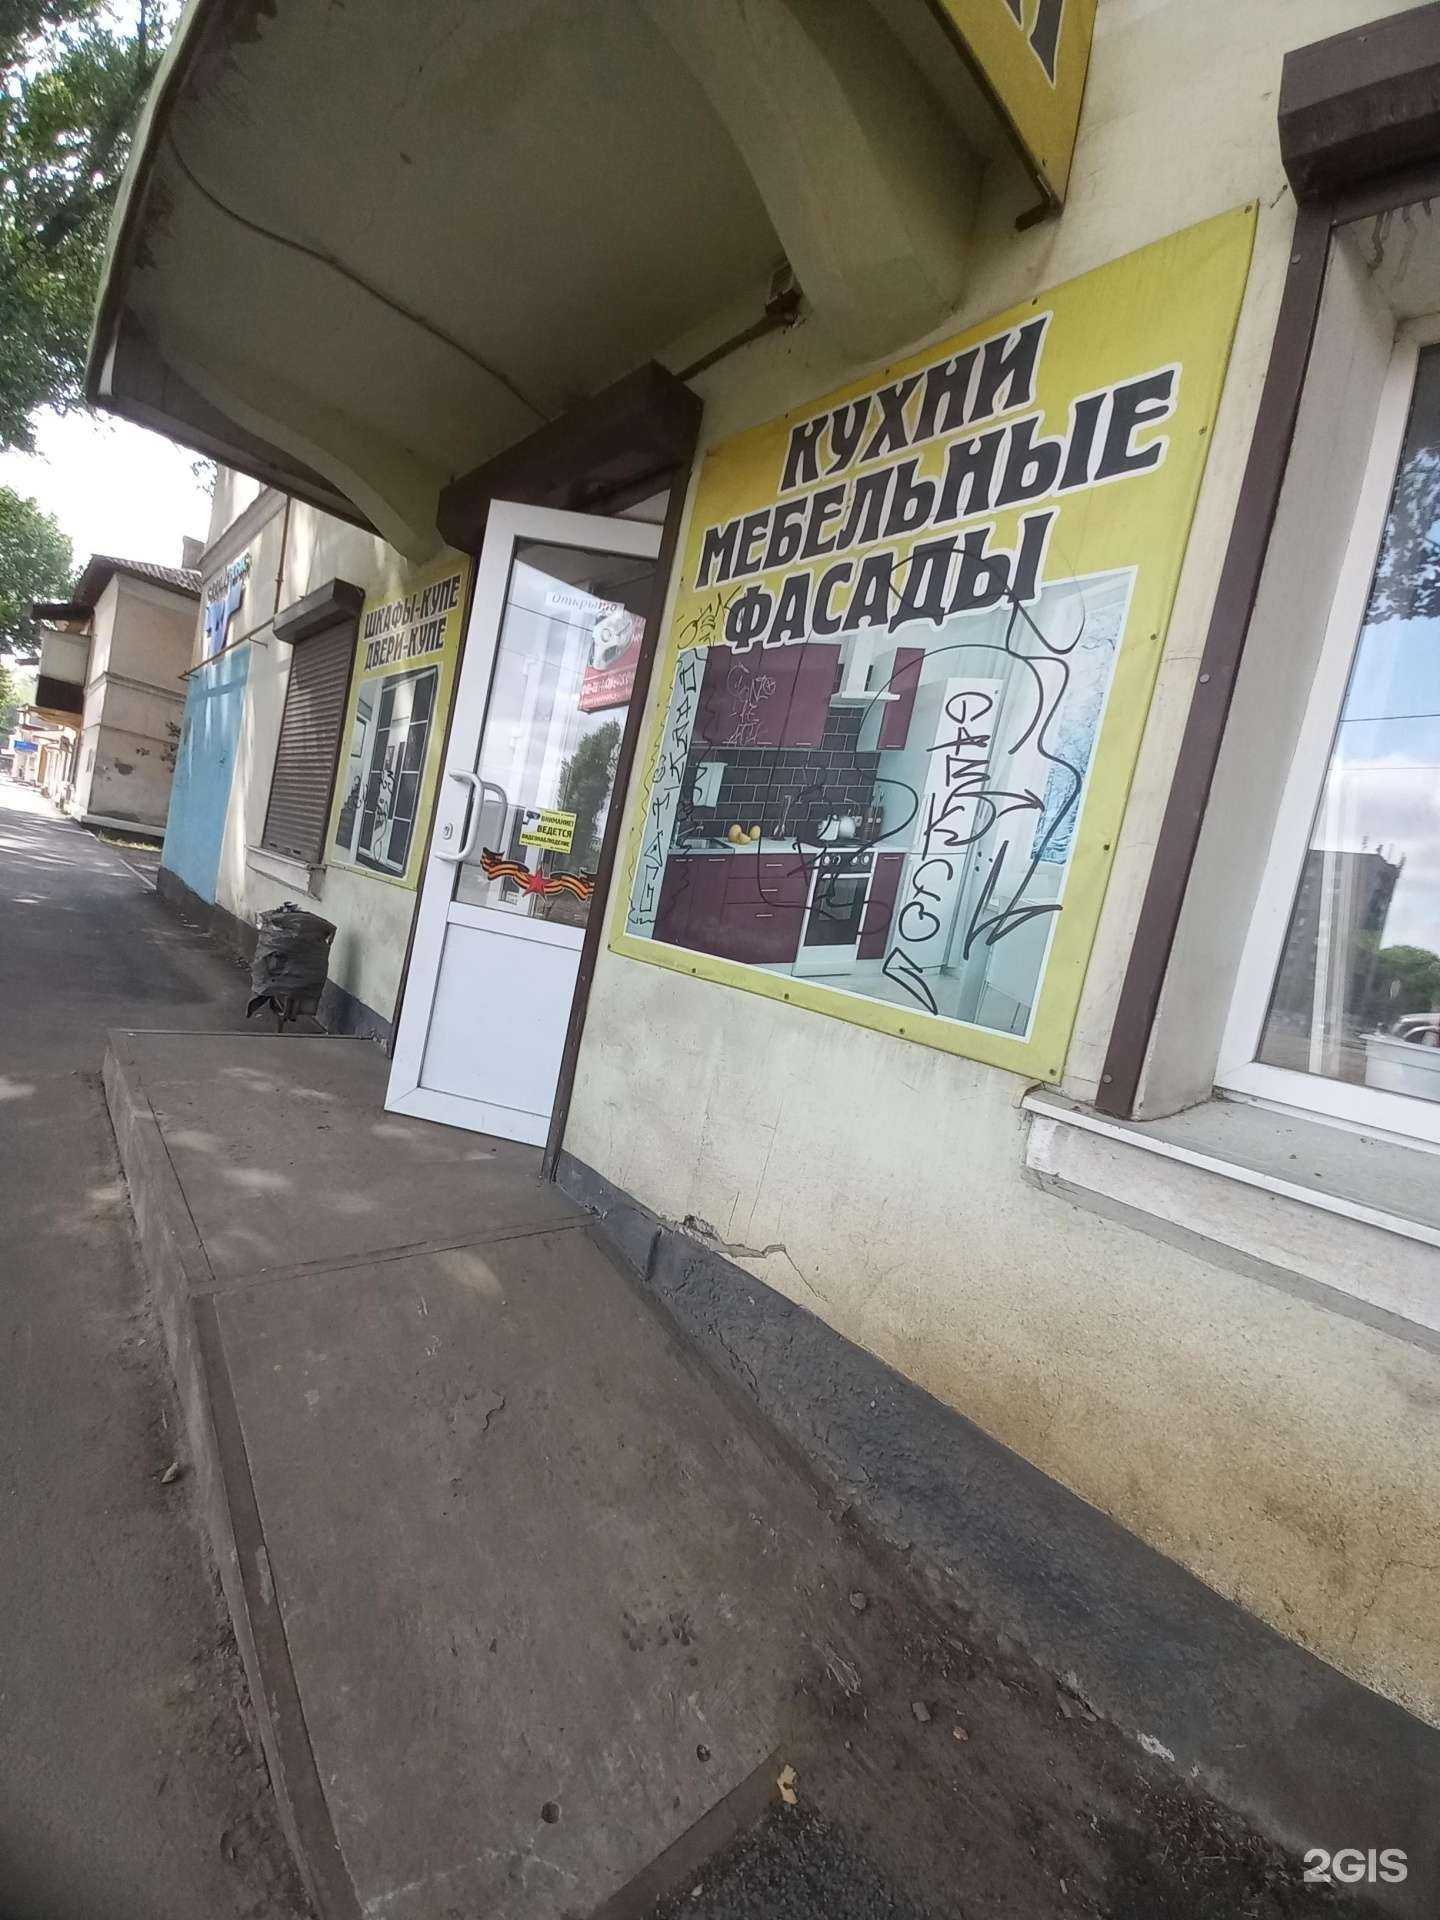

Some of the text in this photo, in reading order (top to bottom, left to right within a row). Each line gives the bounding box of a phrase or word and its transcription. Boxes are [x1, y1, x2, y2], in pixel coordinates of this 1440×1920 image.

[779, 318, 1047, 491] КУХНИ
[695, 369, 1176, 589] МЕБЕЛЬНЫЕ
[364, 576, 460, 639] ШКАФЫ-КУПЕ
[724, 511, 1055, 648] ФАСАДЫ
[365, 617, 447, 670] ДВЕРИ-КУПЕ
[537, 824, 572, 838] ВЕДЕТСЯ
